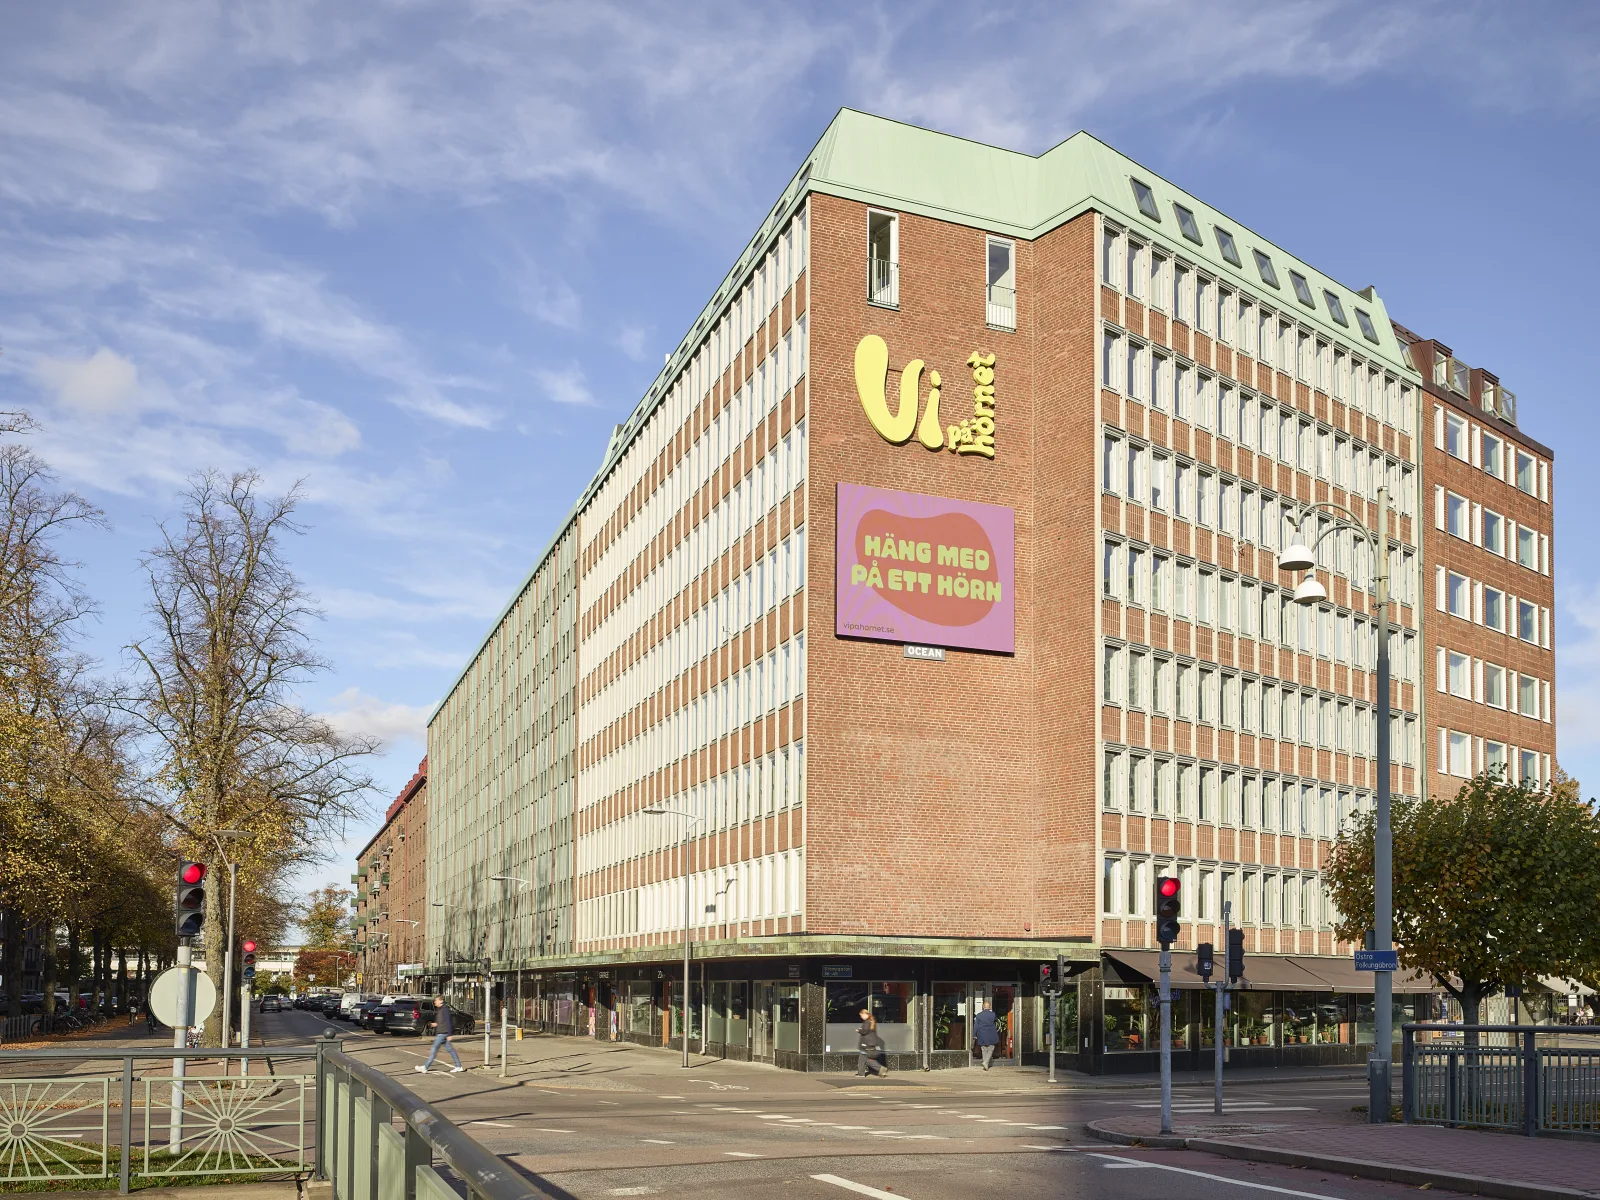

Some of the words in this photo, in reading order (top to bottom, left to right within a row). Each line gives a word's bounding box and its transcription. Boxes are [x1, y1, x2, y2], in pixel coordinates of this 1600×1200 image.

[958, 350, 996, 458] hörnet
[946, 419, 974, 451] på
[864, 533, 932, 564] HÄNG
[937, 544, 990, 571] MED
[851, 559, 884, 589] PÅ
[887, 568, 932, 594] ETT
[937, 571, 1002, 603] HÖRN
[843, 621, 895, 634] vipahornet.se
[907, 646, 942, 658] OCEAN
[1356, 961, 1396, 969] Folkungabron
